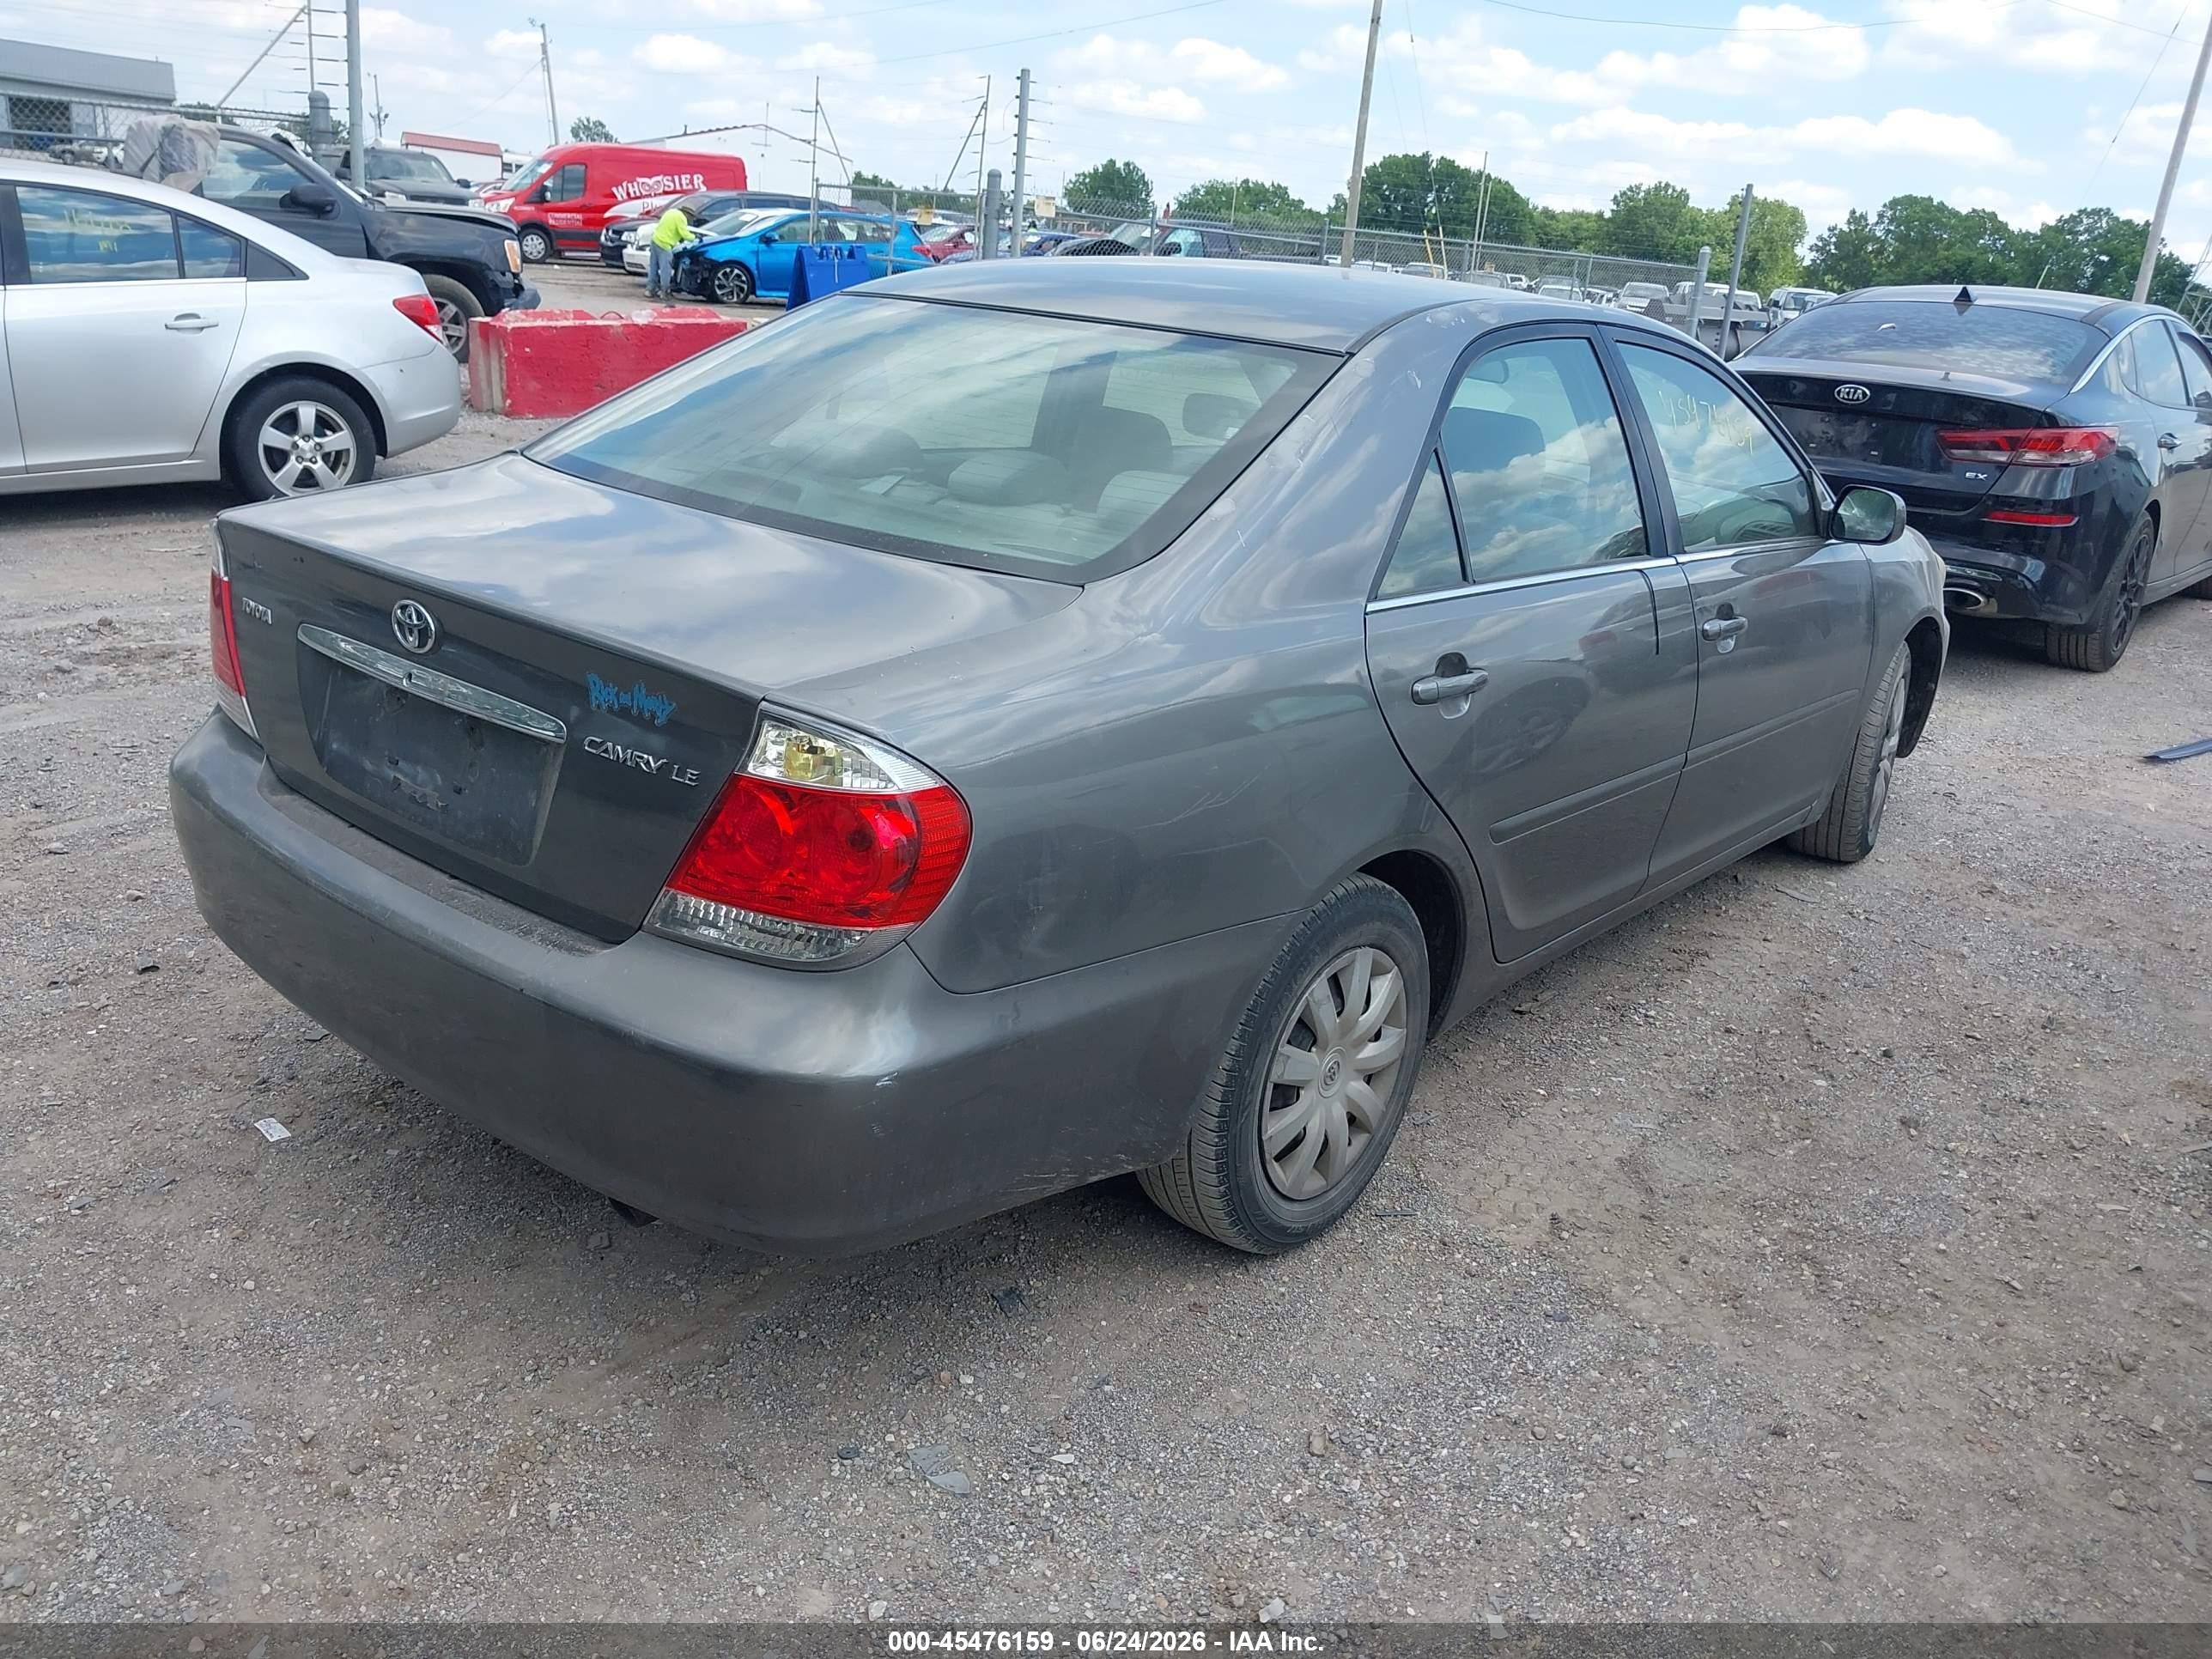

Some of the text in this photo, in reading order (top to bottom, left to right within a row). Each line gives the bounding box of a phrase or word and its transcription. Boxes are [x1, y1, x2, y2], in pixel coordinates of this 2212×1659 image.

[1839, 387, 1863, 400] KIA
[1965, 471, 1988, 481] EX
[242, 597, 272, 625] TOYOTA
[583, 736, 702, 787] CAMRY LE
